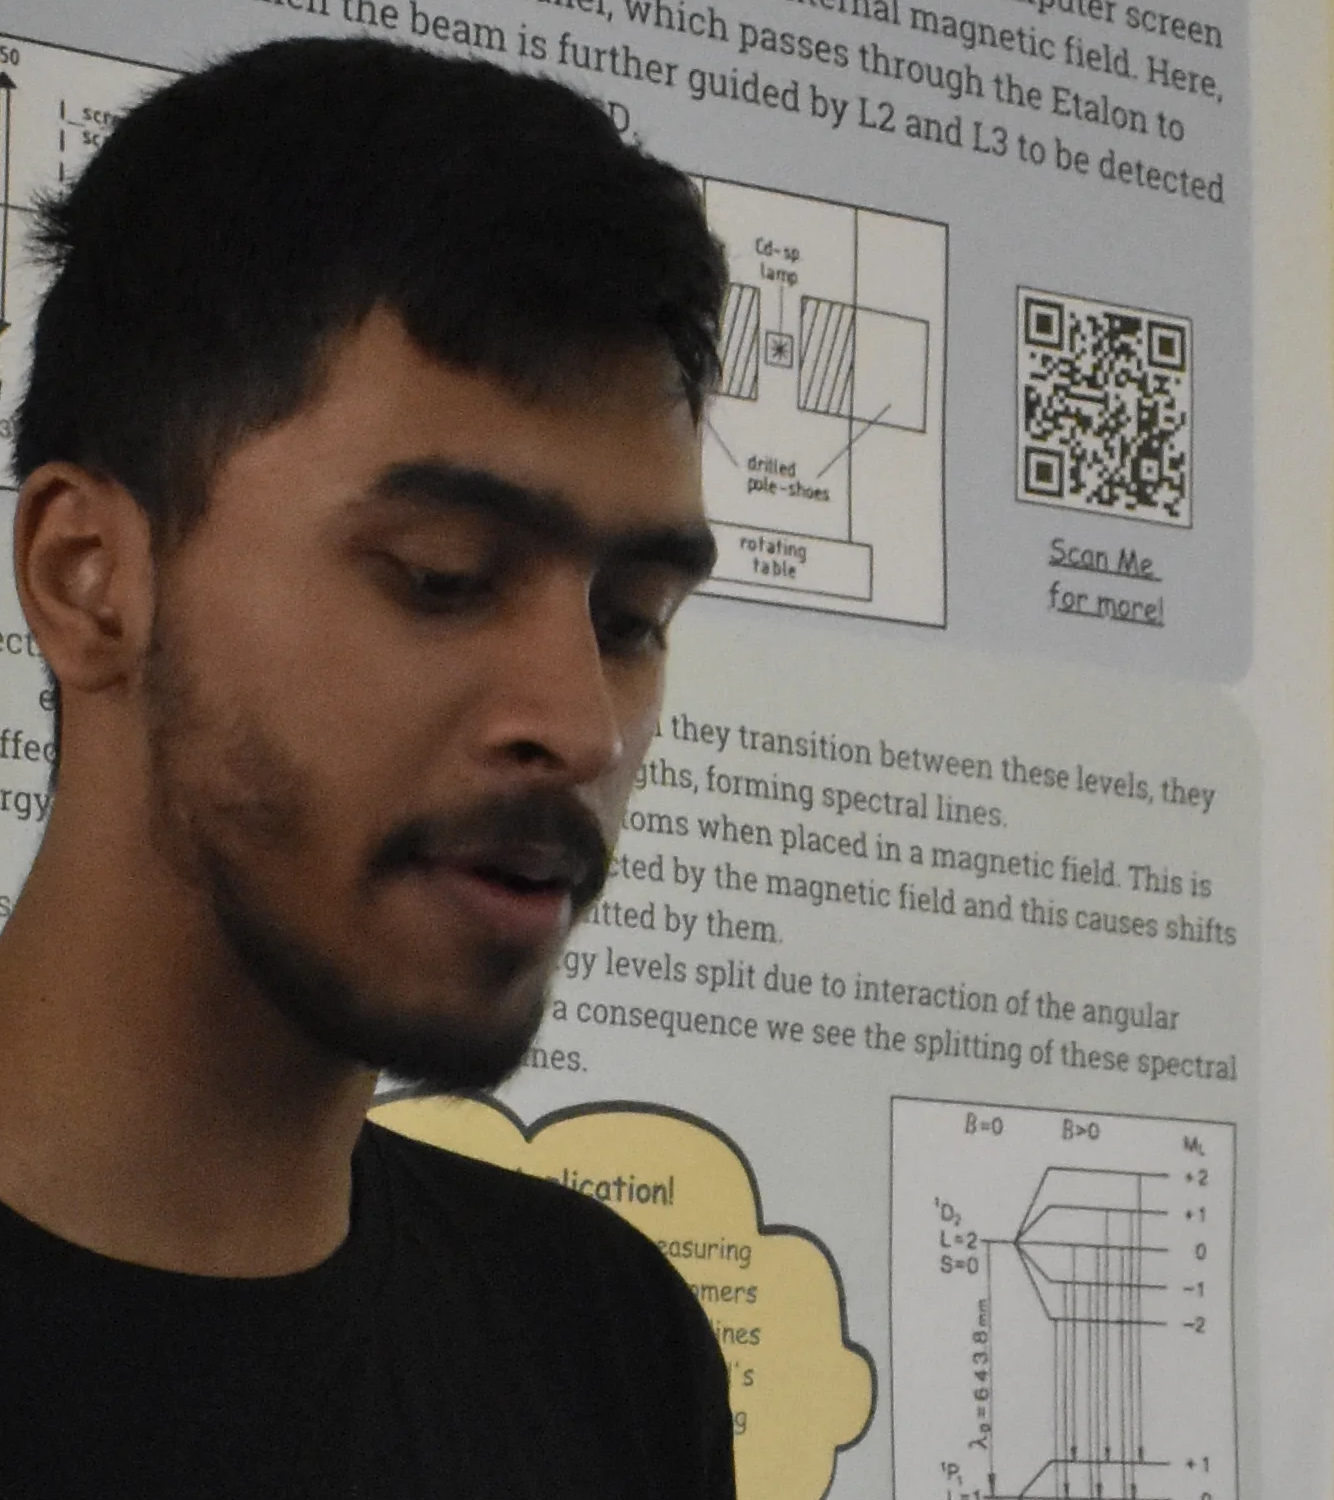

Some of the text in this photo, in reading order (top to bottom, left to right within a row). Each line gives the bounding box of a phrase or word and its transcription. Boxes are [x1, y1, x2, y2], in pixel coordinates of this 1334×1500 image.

[1125, 6, 1223, 49] screen
[409, 0, 507, 52] beam
[517, 22, 547, 60] is
[557, 31, 679, 88] further
[687, 67, 801, 114] guided
[809, 83, 849, 130] by
[858, 96, 896, 134] L2
[905, 114, 963, 148] and
[972, 121, 1008, 157] L3
[1017, 133, 1046, 166] to
[1054, 136, 1090, 176] be
[1099, 148, 1225, 205] detected
[760, 263, 798, 286] lamp
[747, 455, 796, 480] drilled
[747, 476, 830, 504] pole-shoes
[739, 535, 807, 565] rotating
[1050, 538, 1154, 577] Scan Me
[753, 555, 797, 580] table
[1049, 581, 1088, 613] for
[671, 712, 1216, 815] they transition between these levels, they
[705, 764, 1007, 828] forming spectral lines.
